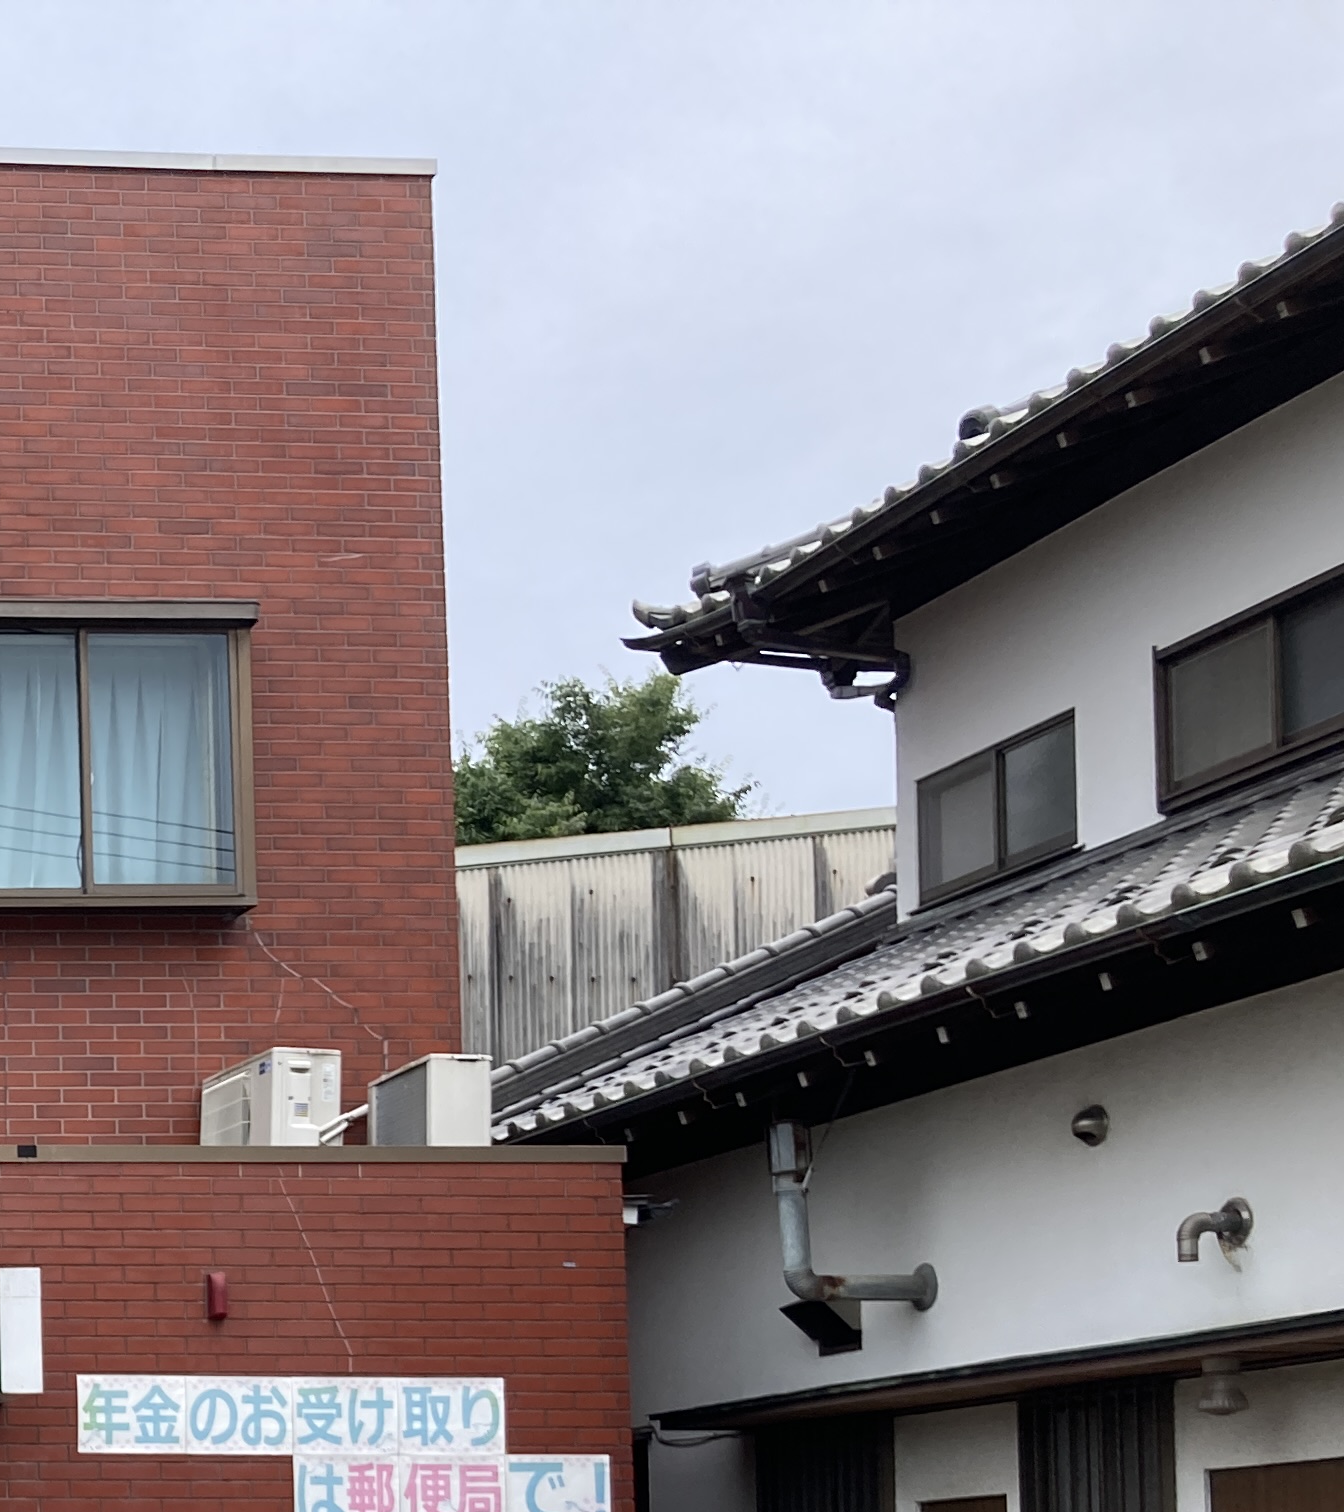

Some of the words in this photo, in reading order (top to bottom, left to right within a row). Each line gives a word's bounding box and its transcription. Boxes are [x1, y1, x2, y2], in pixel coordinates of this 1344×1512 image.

[81, 1382, 500, 1447] 年金のお受け取り
